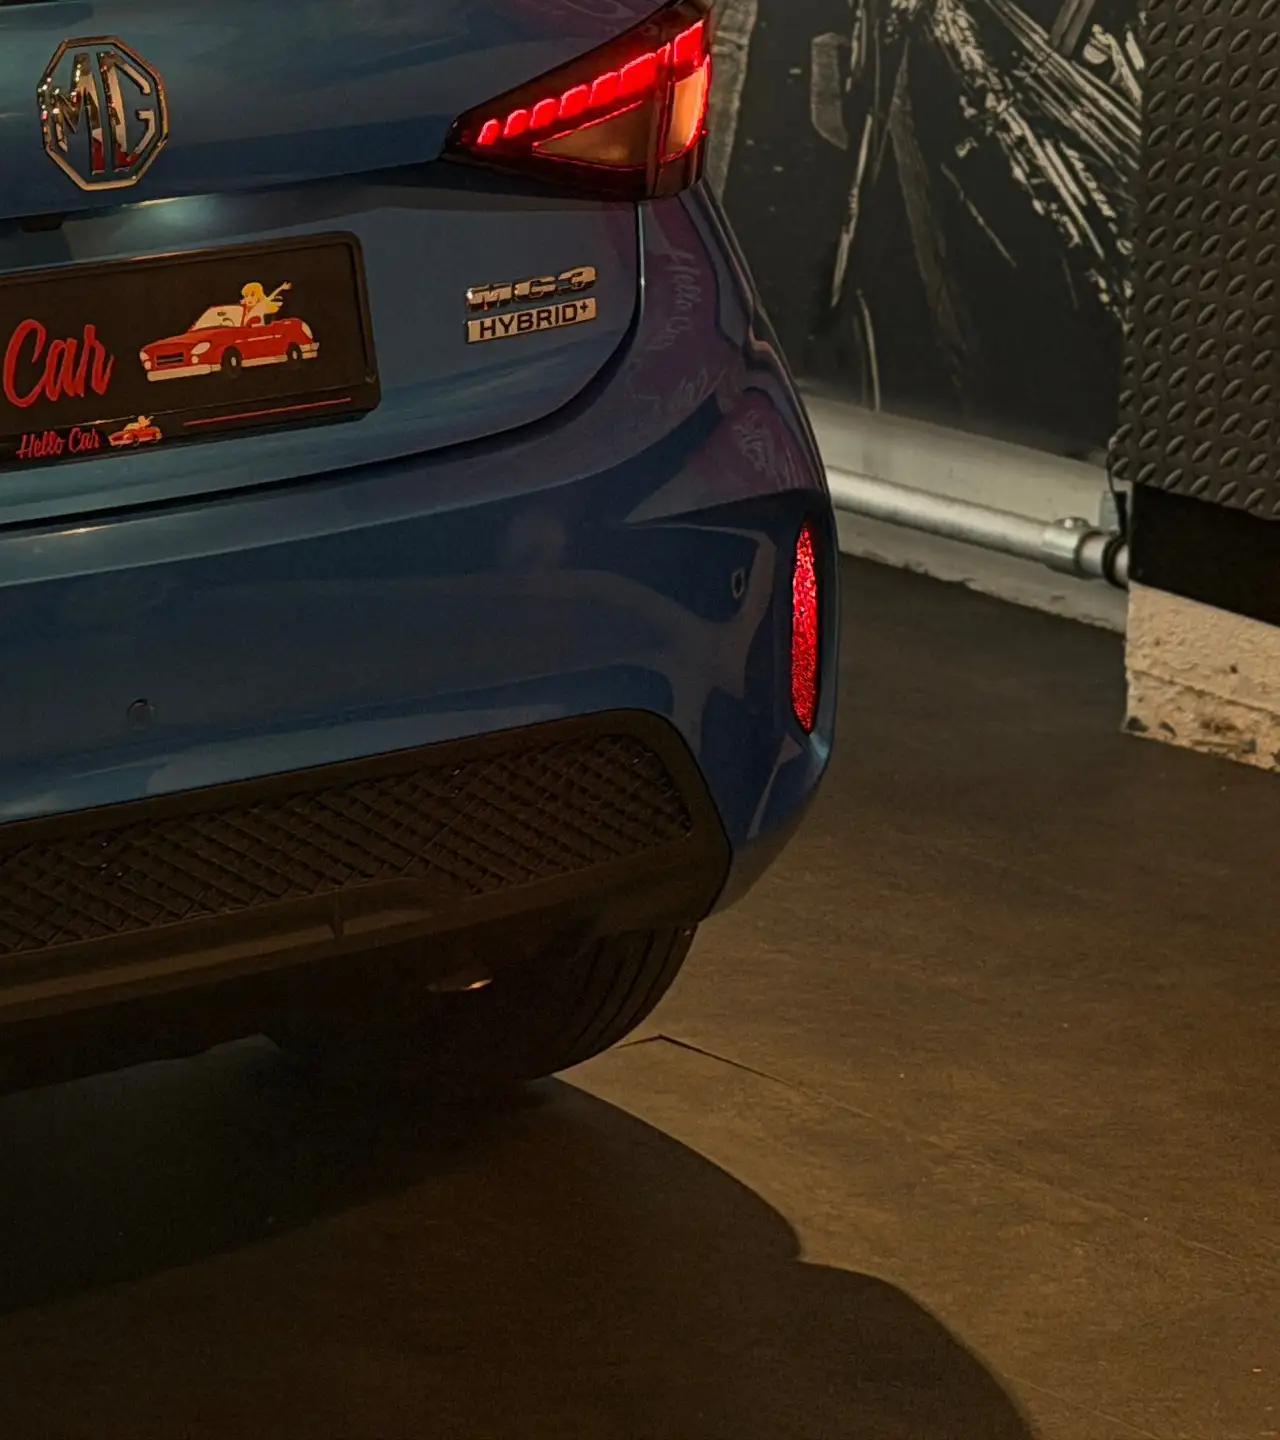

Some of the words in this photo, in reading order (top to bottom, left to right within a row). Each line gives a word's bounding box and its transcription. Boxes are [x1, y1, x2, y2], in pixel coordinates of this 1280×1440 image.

[44, 50, 156, 175] MG
[465, 265, 597, 311] MG3
[3, 318, 115, 409] Car
[15, 431, 65, 462] Hello
[67, 425, 100, 452] Car
